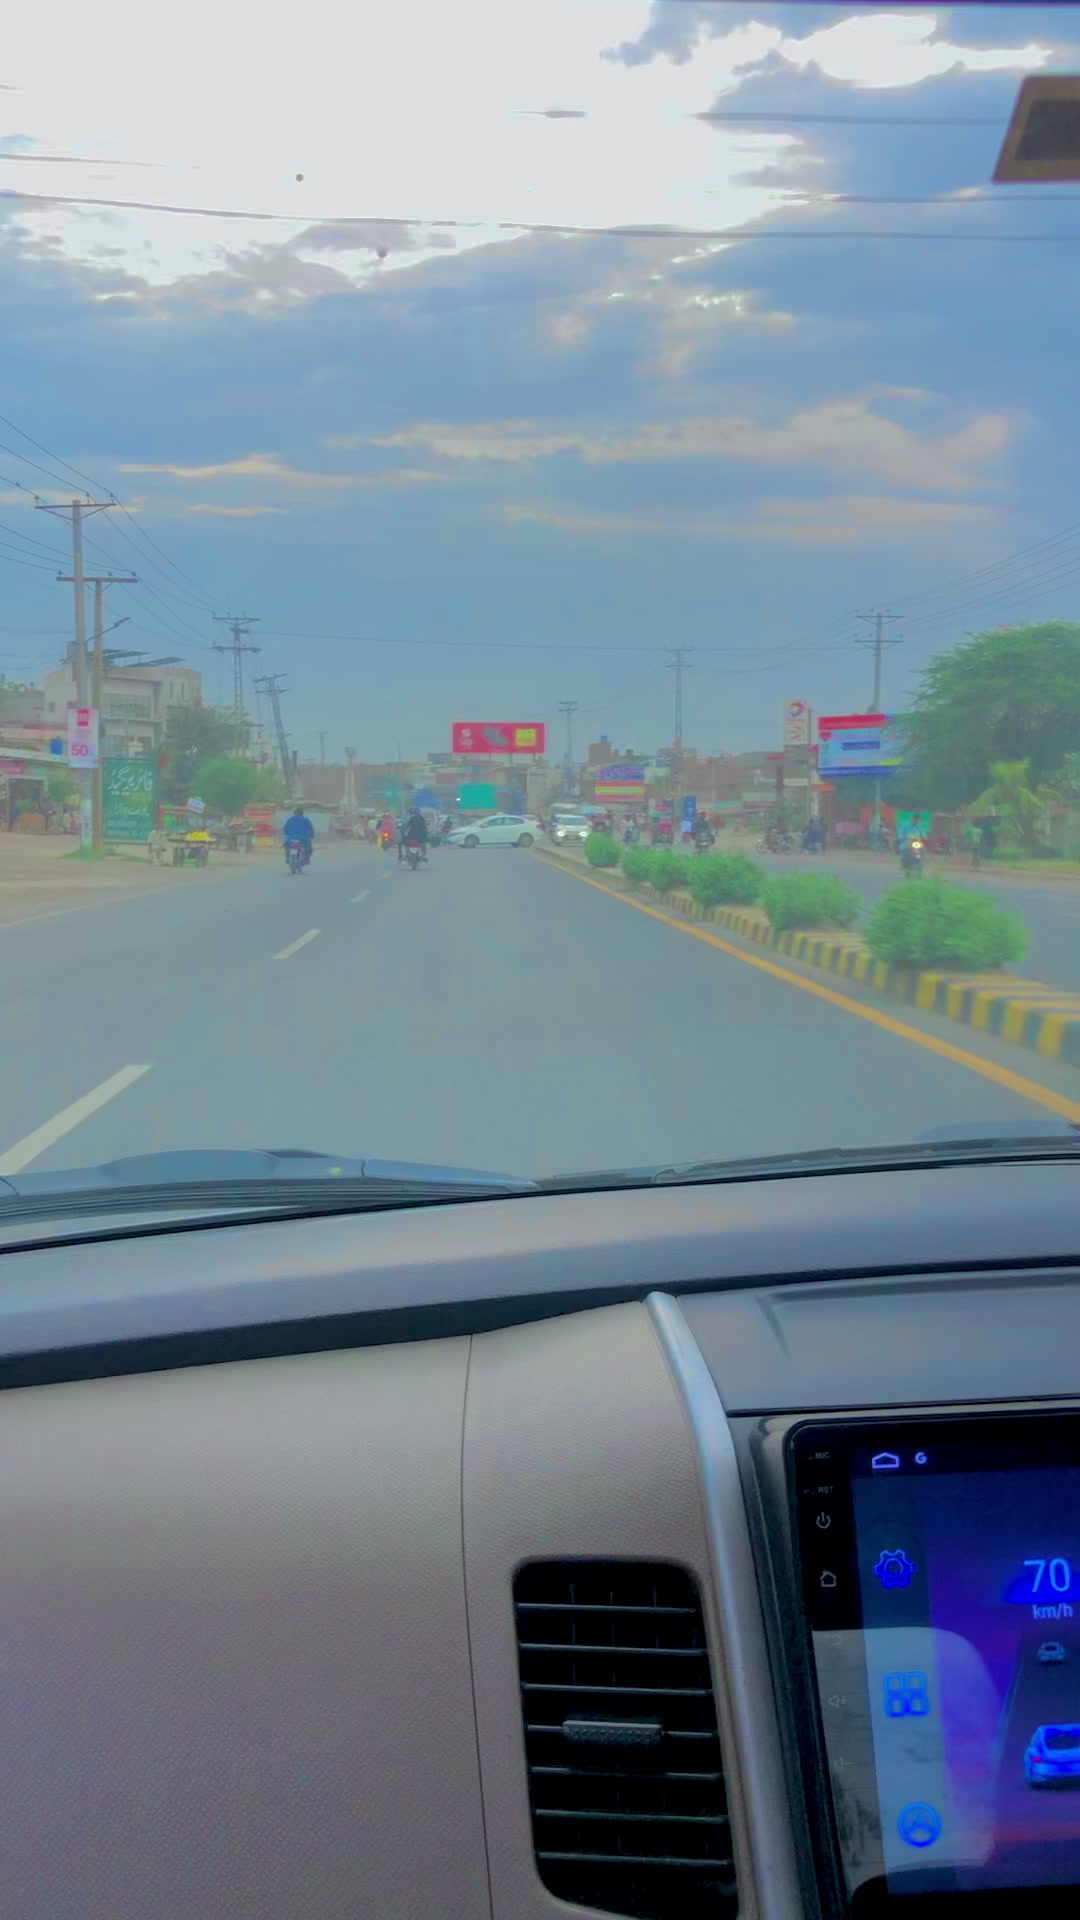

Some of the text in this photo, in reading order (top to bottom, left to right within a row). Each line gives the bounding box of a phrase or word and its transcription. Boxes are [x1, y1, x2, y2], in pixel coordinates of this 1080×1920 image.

[71, 743, 89, 757] 50
[131, 768, 153, 791] فائر
[815, 1451, 832, 1460] MIC
[817, 1486, 834, 1495] RST
[1023, 1558, 1070, 1593] 70
[1032, 1602, 1073, 1620] km/h
